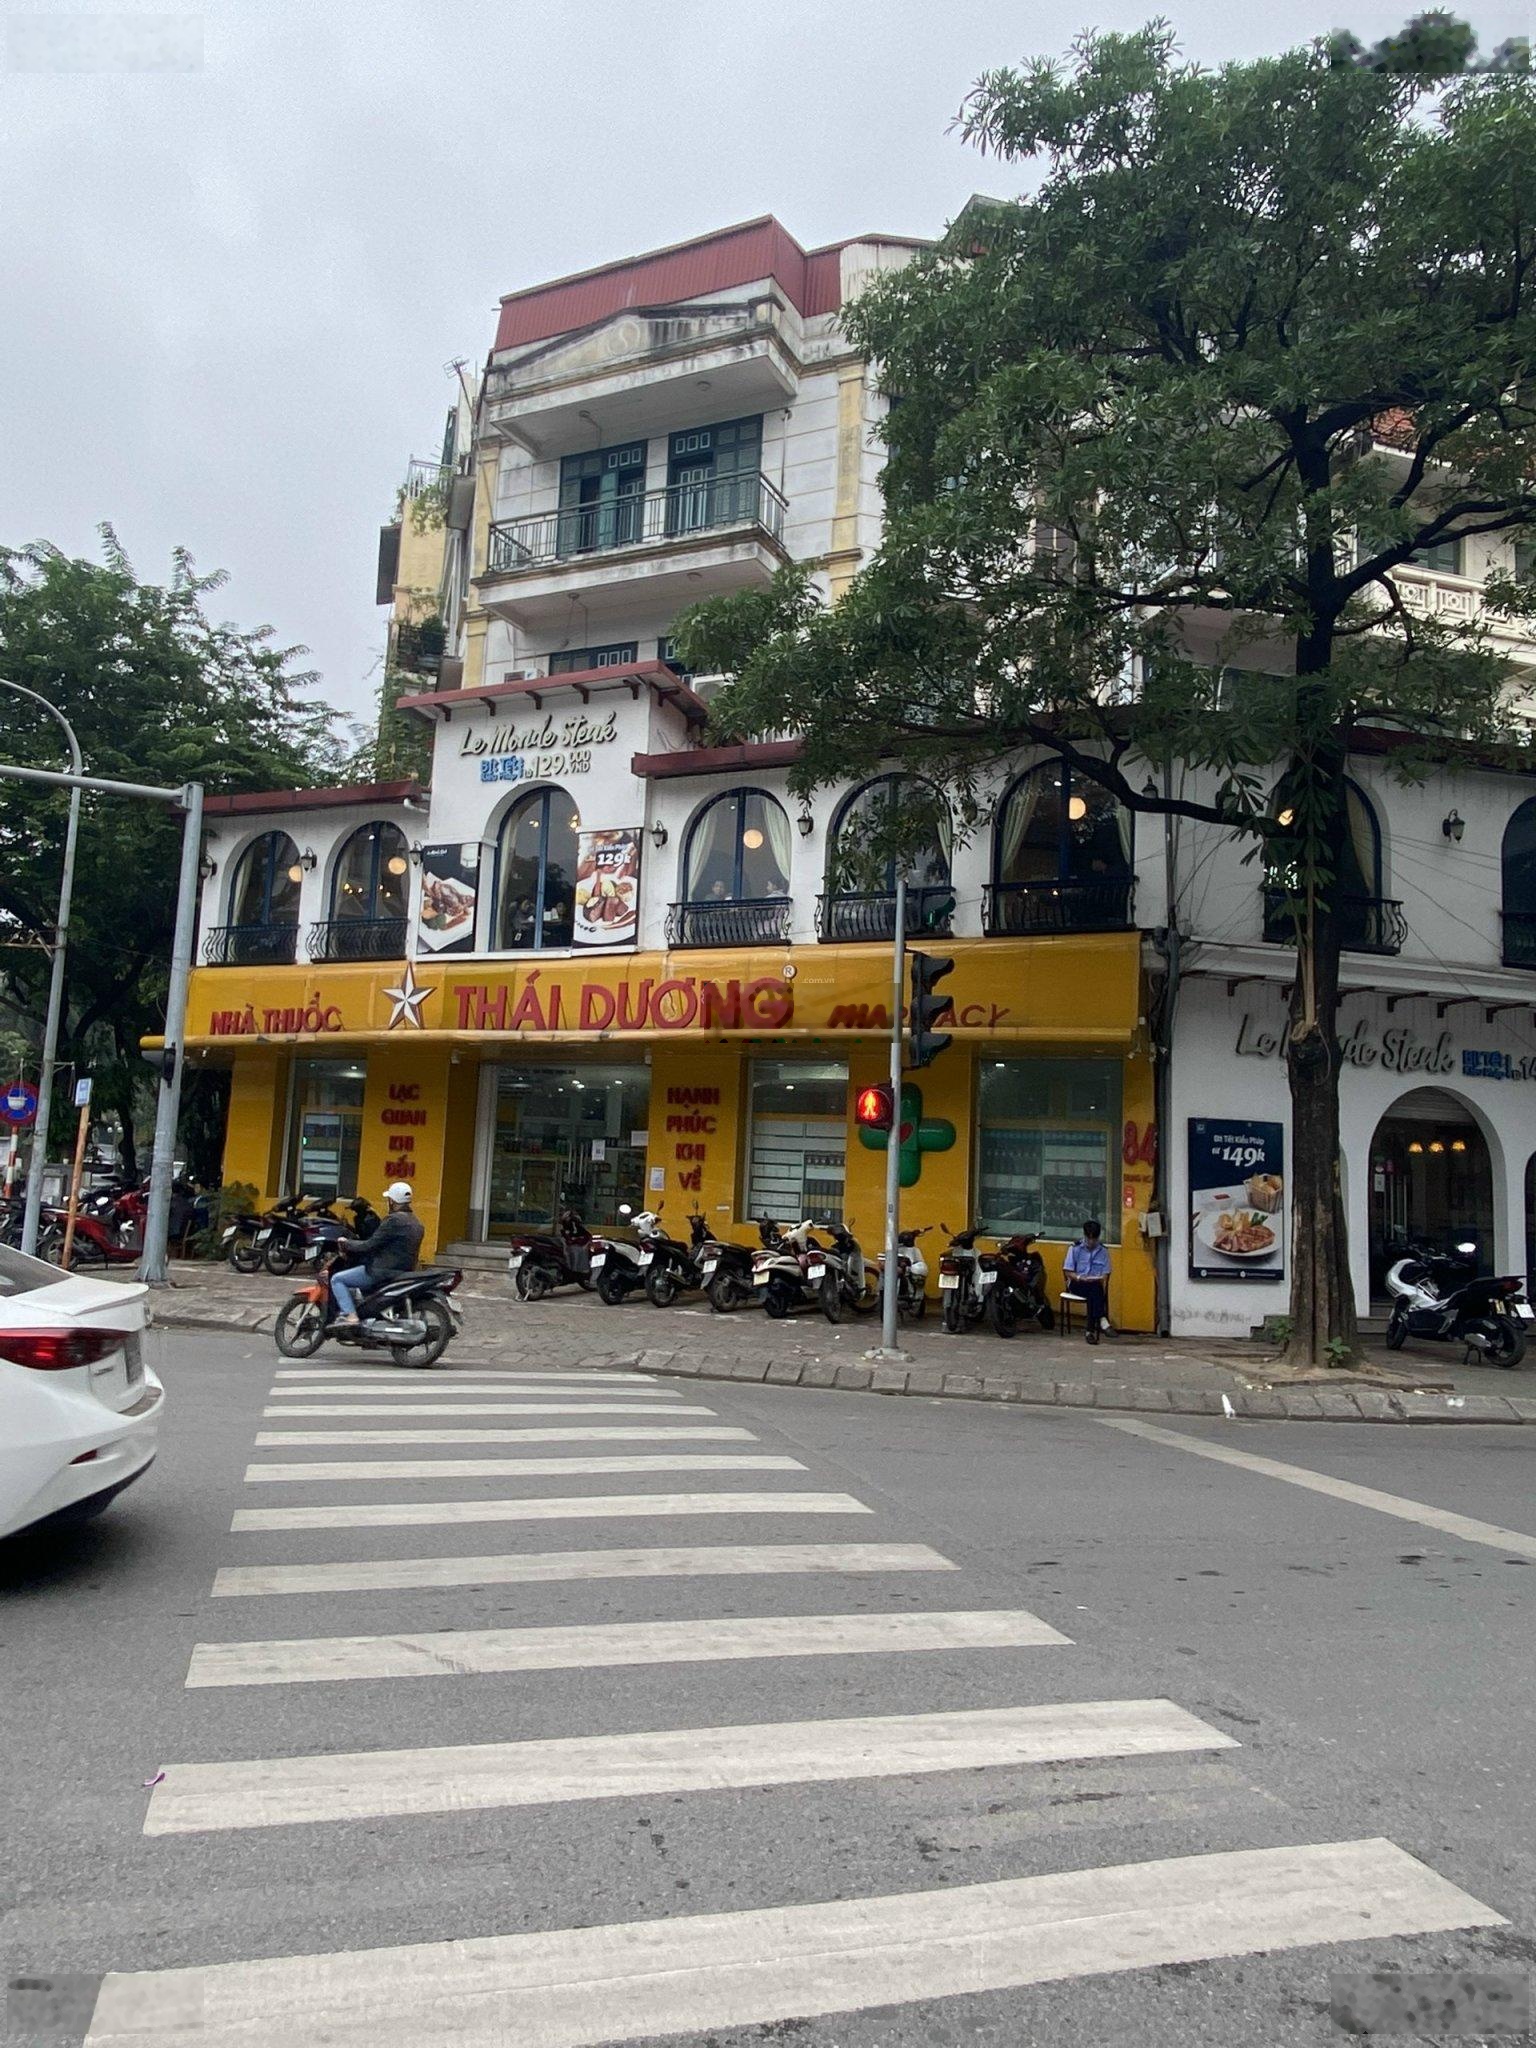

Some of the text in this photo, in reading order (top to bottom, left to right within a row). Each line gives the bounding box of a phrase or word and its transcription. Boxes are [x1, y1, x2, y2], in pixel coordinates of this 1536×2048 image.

[460, 711, 618, 757] Le Monde Steak
[210, 991, 342, 1035] NHÀ THUỐC
[454, 969, 562, 1031] THÁI
[578, 976, 795, 1030] DƯƠNG
[1235, 1014, 1277, 1057] Le
[666, 1109, 716, 1134] PHÚC
